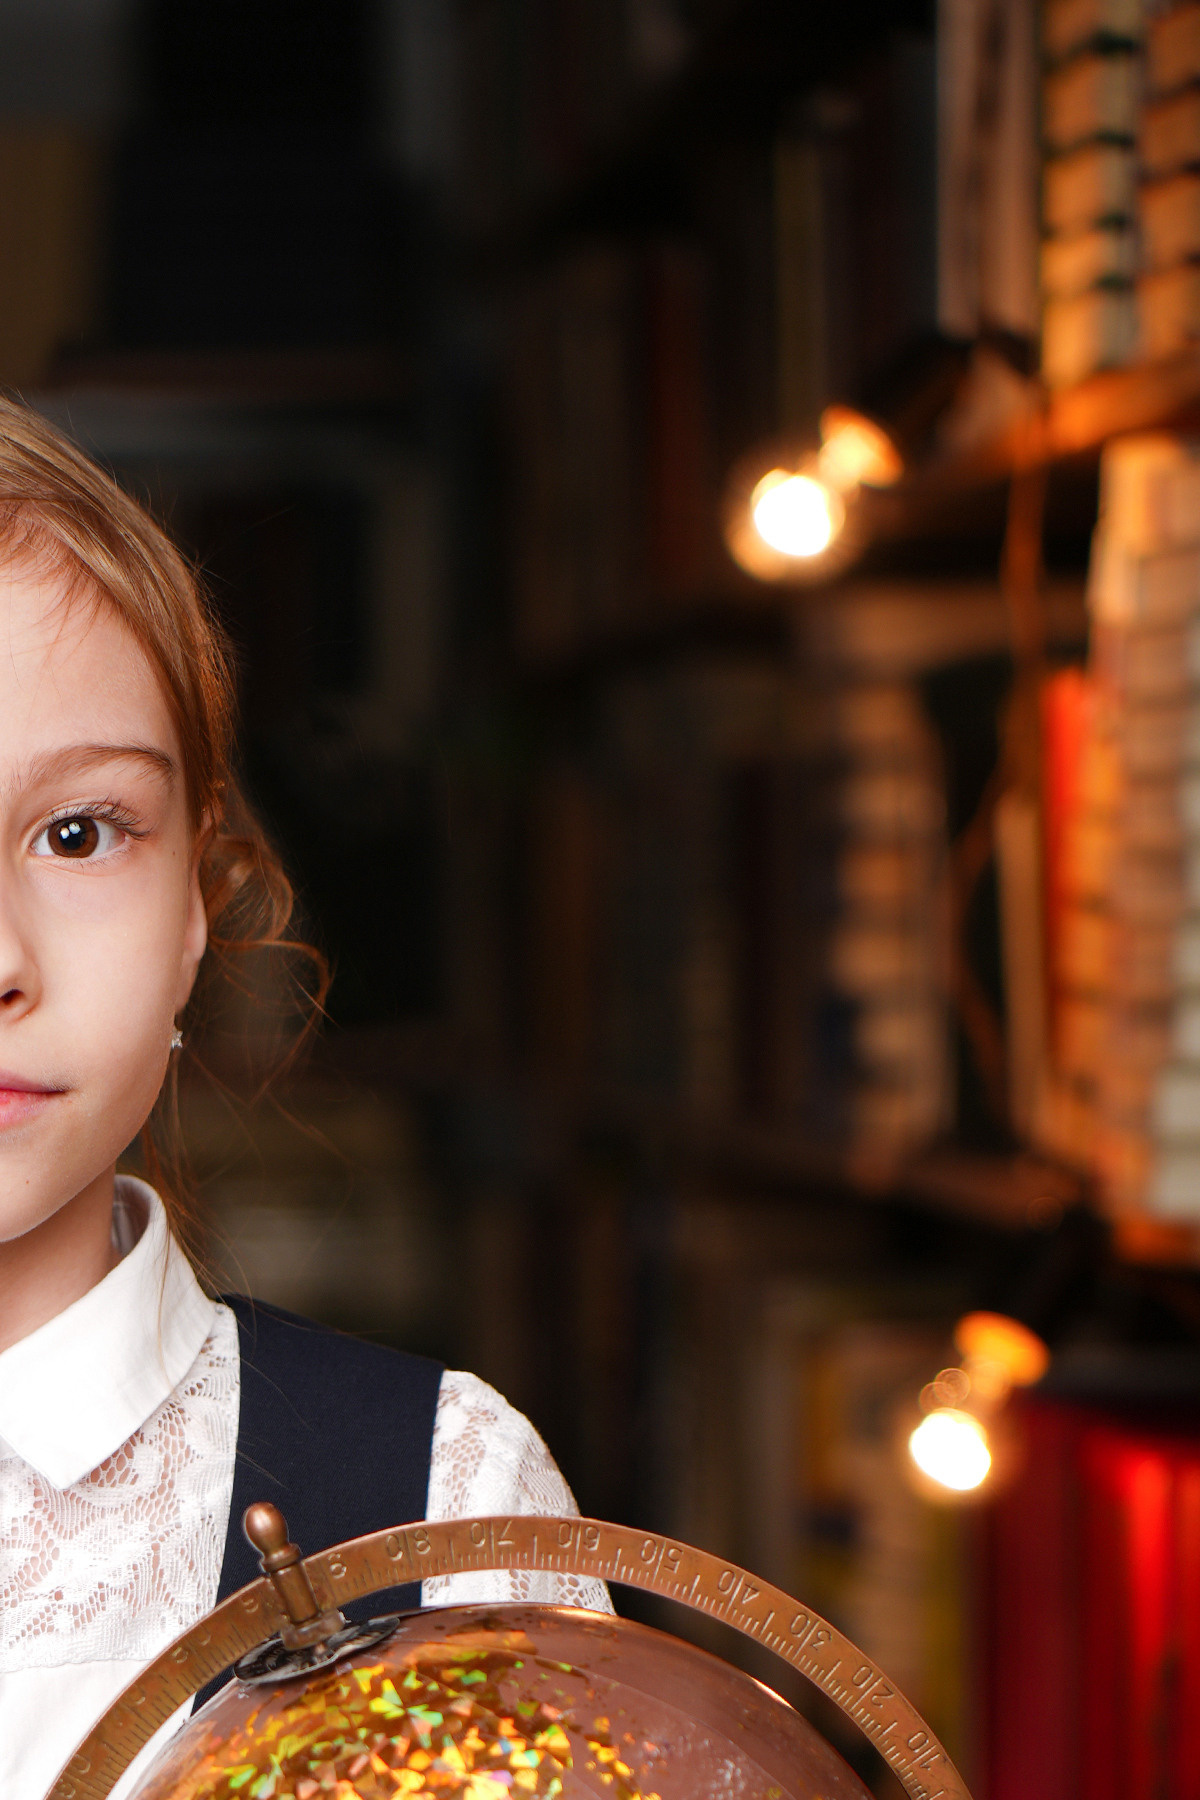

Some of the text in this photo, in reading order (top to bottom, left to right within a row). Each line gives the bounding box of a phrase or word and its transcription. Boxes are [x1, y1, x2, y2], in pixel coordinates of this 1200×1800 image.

[385, 1529, 432, 1561] 80
[470, 1520, 515, 1548] 70
[559, 1521, 600, 1551] 60
[640, 1539, 683, 1575] 50
[717, 1570, 760, 1605] 40
[790, 1613, 833, 1651] 30
[852, 1665, 895, 1708] 20
[907, 1730, 941, 1771] 10
